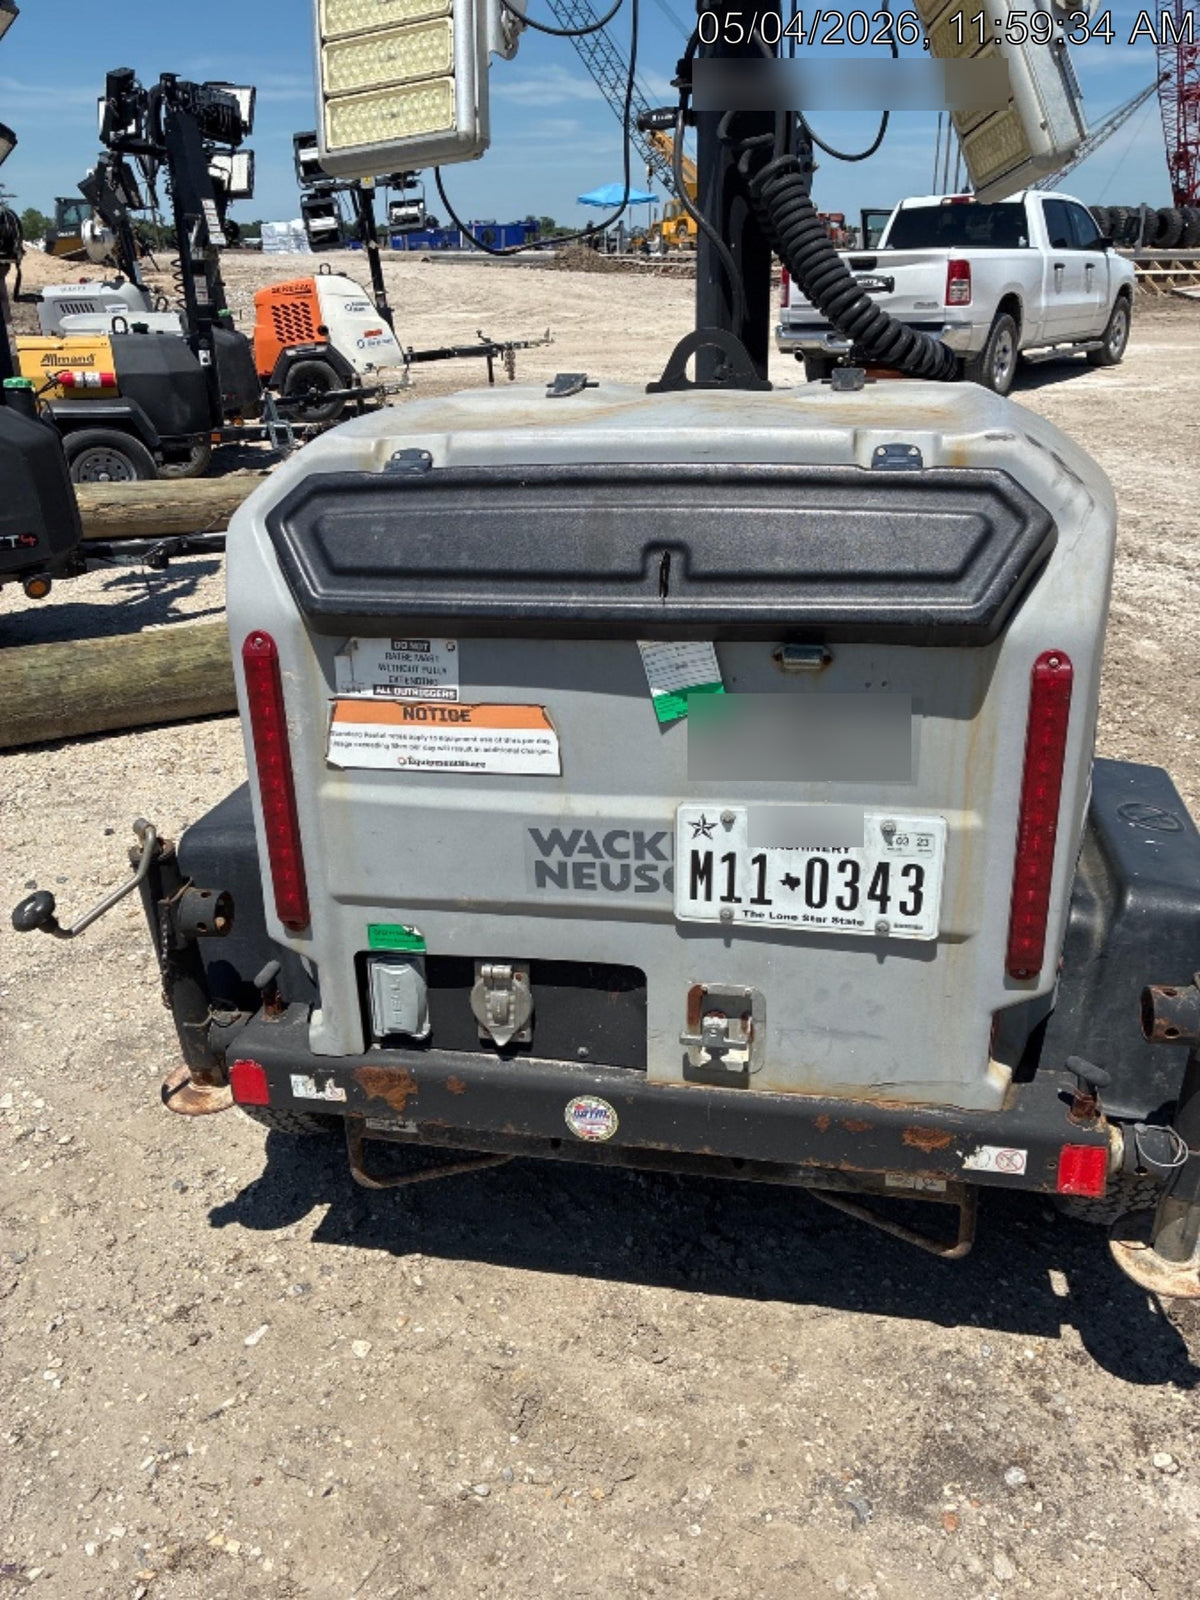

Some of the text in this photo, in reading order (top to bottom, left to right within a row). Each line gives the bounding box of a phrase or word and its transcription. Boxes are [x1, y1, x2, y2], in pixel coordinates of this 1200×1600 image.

[40, 353, 95, 366] Allmand
[394, 641, 429, 652] DO NOT
[377, 662, 419, 673] WITHOUT
[388, 675, 438, 686] EXTENDING
[375, 686, 391, 695] ALL
[393, 687, 457, 700] OUTRIGGERS
[403, 706, 472, 723] NOTICE
[527, 828, 673, 861] WACK
[689, 849, 925, 917] M11 0343
[742, 909, 865, 926] The Lone Star State
